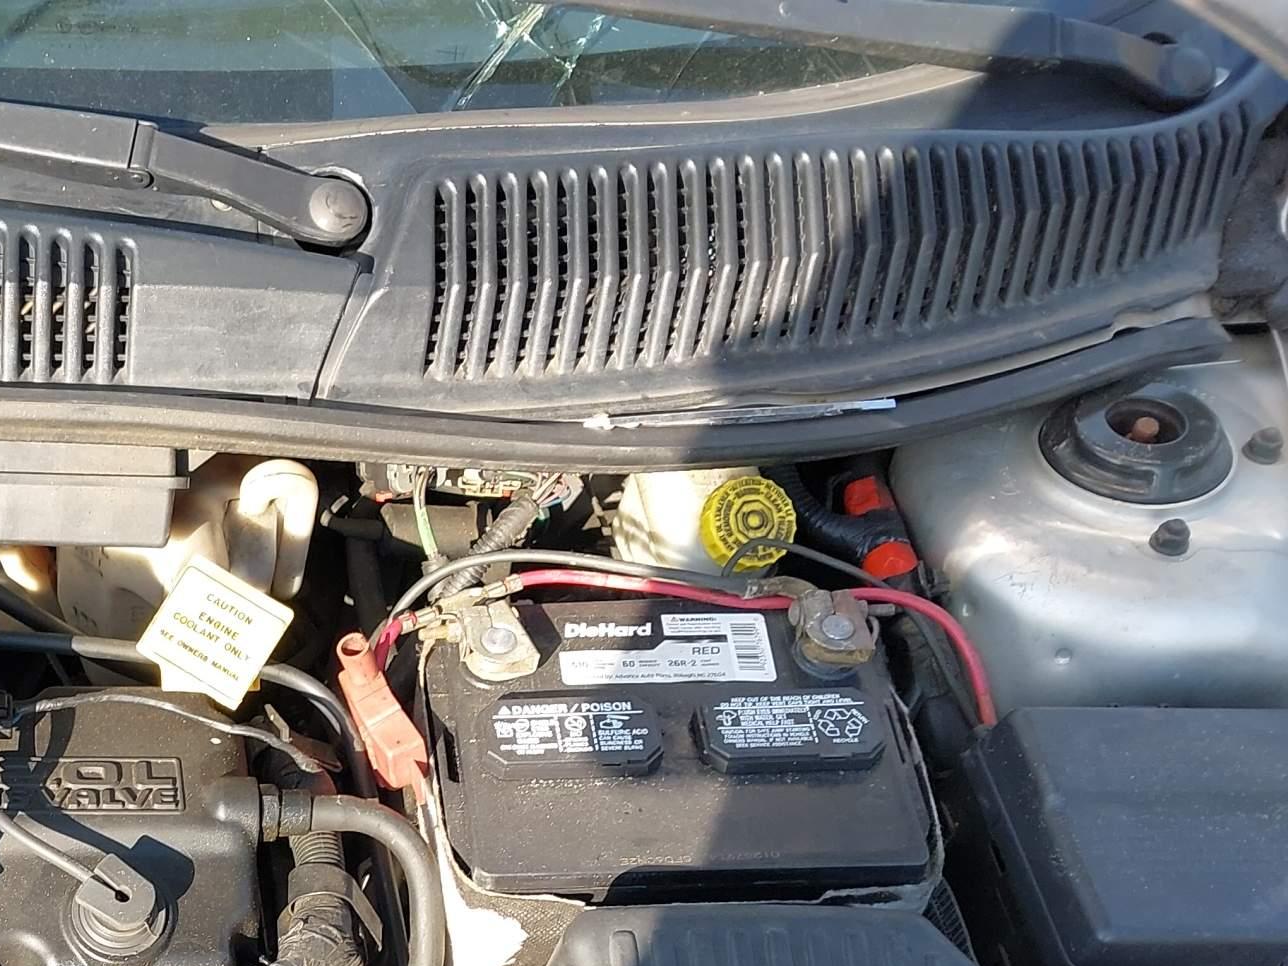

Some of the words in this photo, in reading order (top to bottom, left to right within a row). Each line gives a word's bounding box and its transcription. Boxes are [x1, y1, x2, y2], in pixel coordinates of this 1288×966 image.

[206, 593, 254, 625] CAUTION
[173, 612, 221, 643] COOLANT
[224, 643, 252, 662] ONLY
[198, 611, 240, 641] ENGINE
[564, 621, 652, 639] DieHard
[692, 646, 721, 656] RED
[512, 704, 568, 714] DANGER
[581, 702, 632, 711] POISON
[42, 787, 180, 809] VALVE
